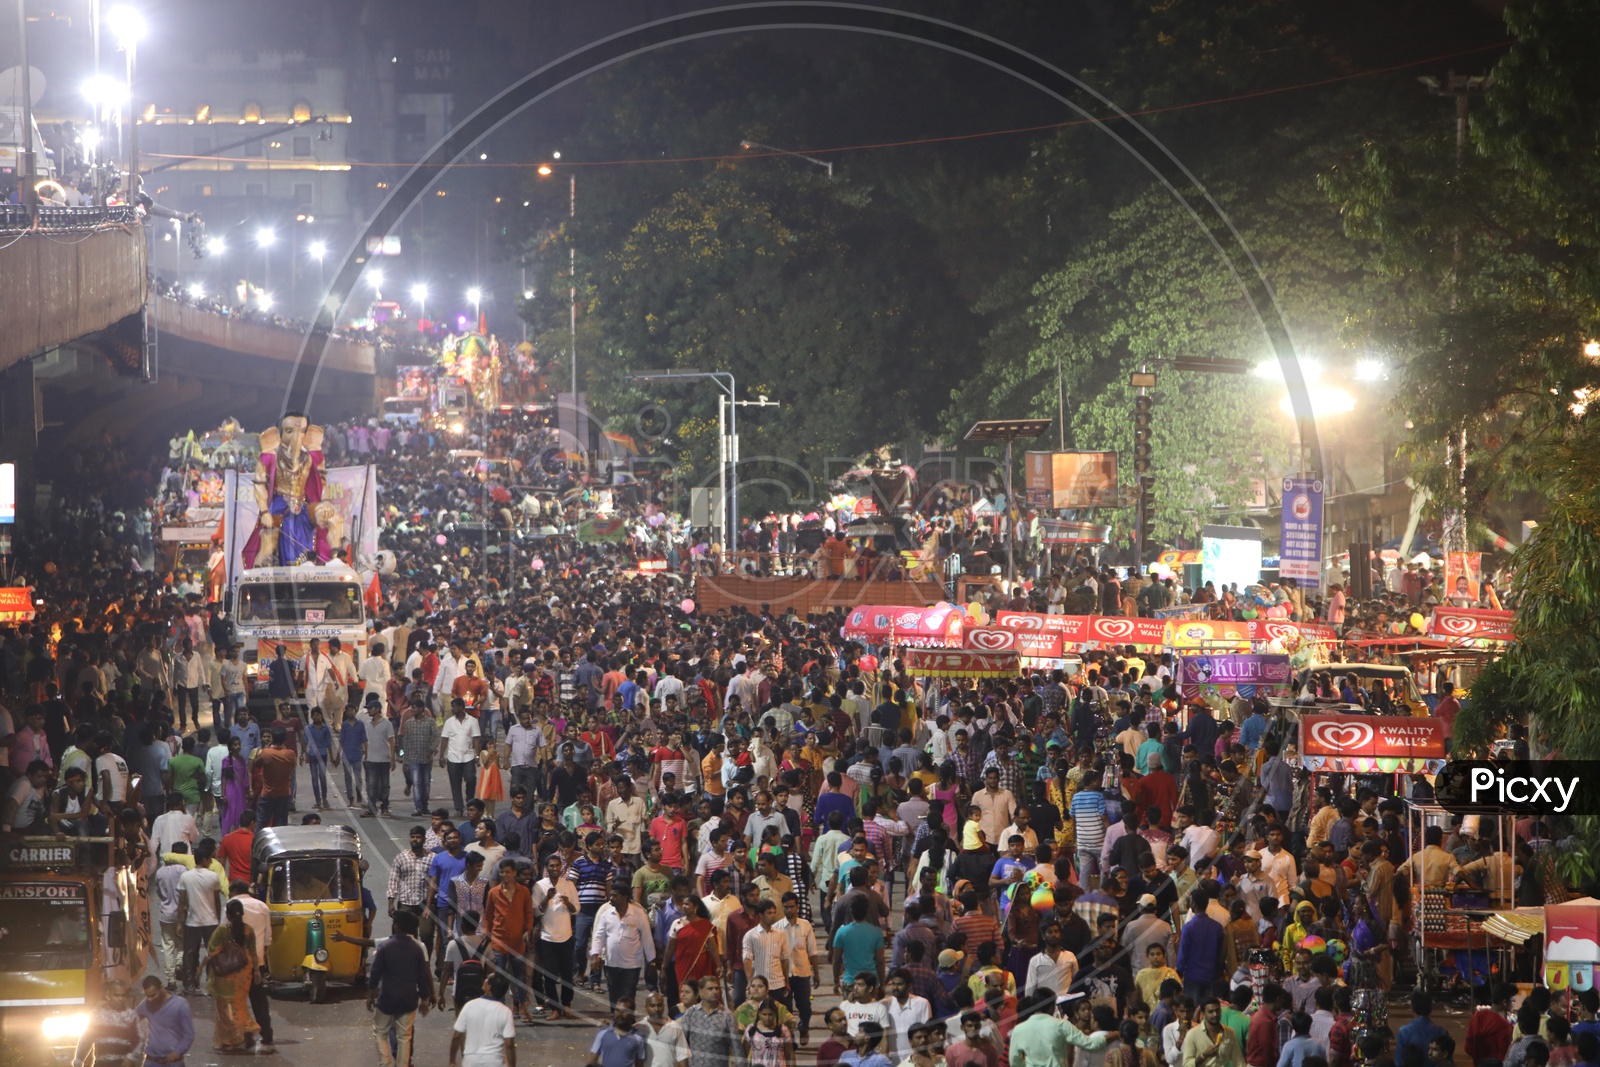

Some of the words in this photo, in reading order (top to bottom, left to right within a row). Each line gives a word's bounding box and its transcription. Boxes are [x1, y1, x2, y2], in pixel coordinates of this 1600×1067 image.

[1021, 640, 1052, 649] WALL'S
[1214, 658, 1262, 677] KULFI
[1379, 727, 1434, 735] KWALITY
[1385, 737, 1428, 746] WALL'S
[10, 848, 71, 861] CARRIER
[0, 887, 78, 897] ANSPORT
